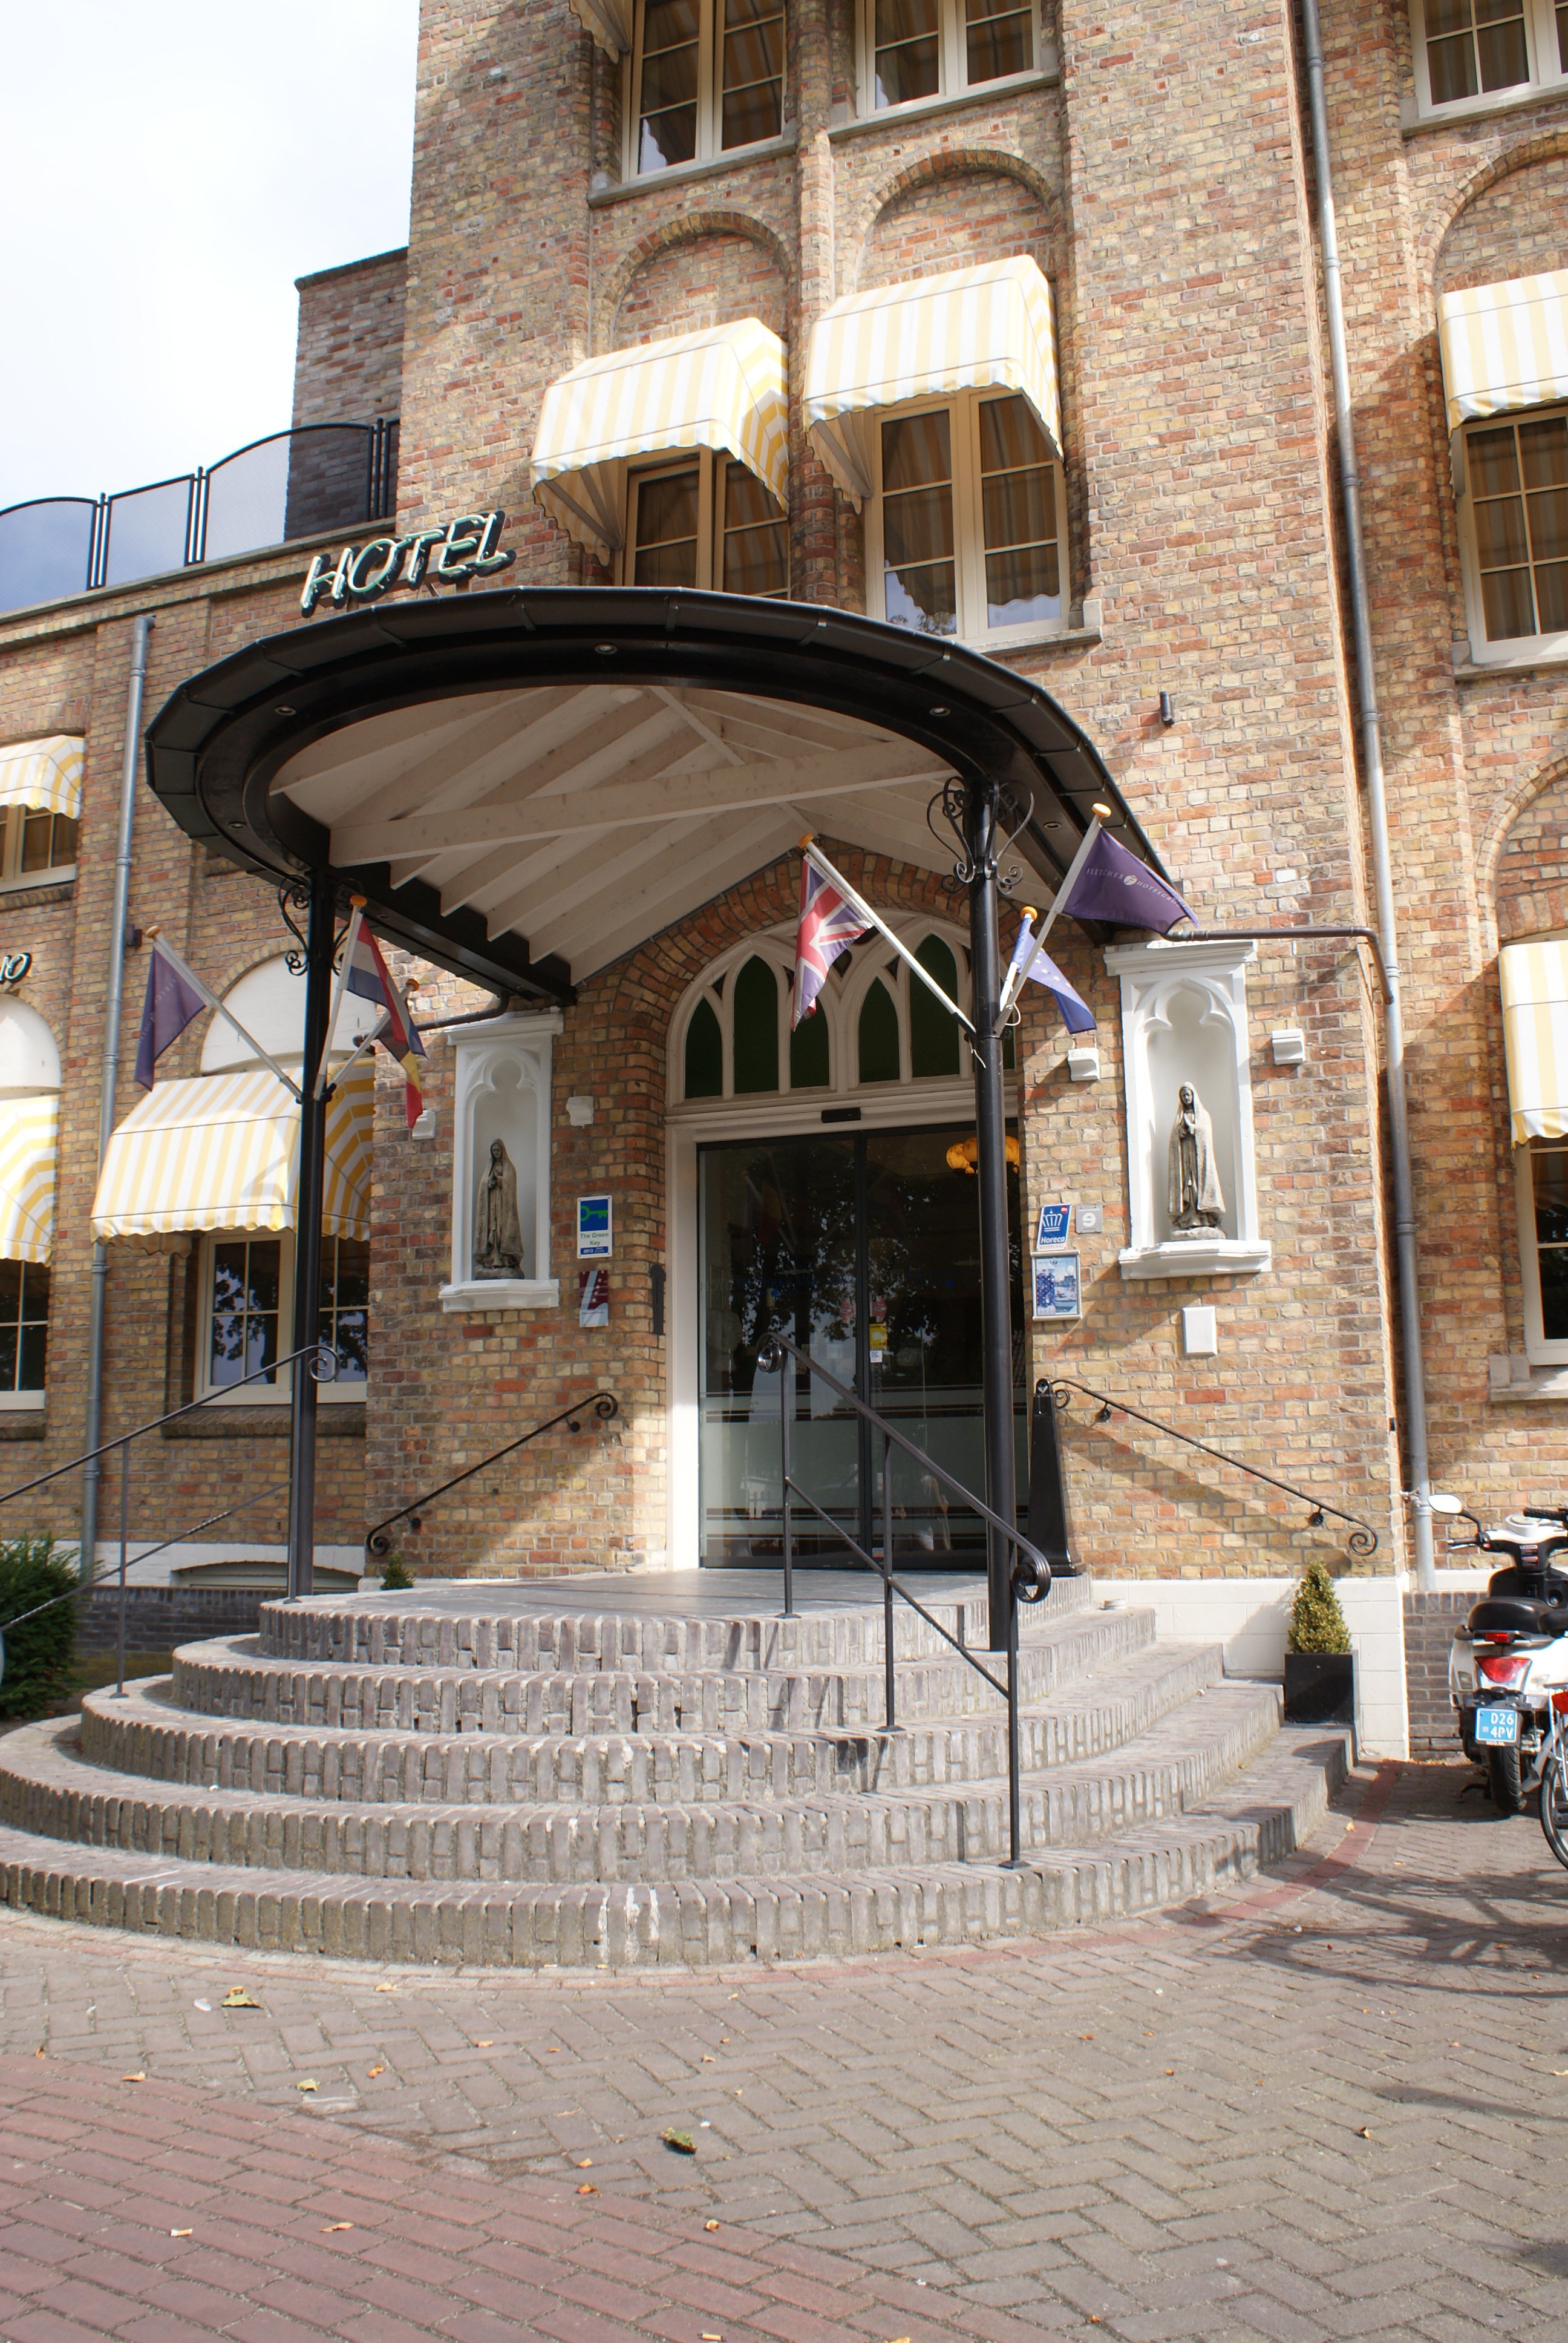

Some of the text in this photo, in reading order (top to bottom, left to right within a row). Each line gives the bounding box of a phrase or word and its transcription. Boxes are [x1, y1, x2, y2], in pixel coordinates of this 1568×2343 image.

[301, 510, 516, 618] HOTEL
[1086, 868, 1123, 880] FLETCHER
[1491, 1712, 1514, 1725] D26
[1490, 1726, 1514, 1739] 4PV
